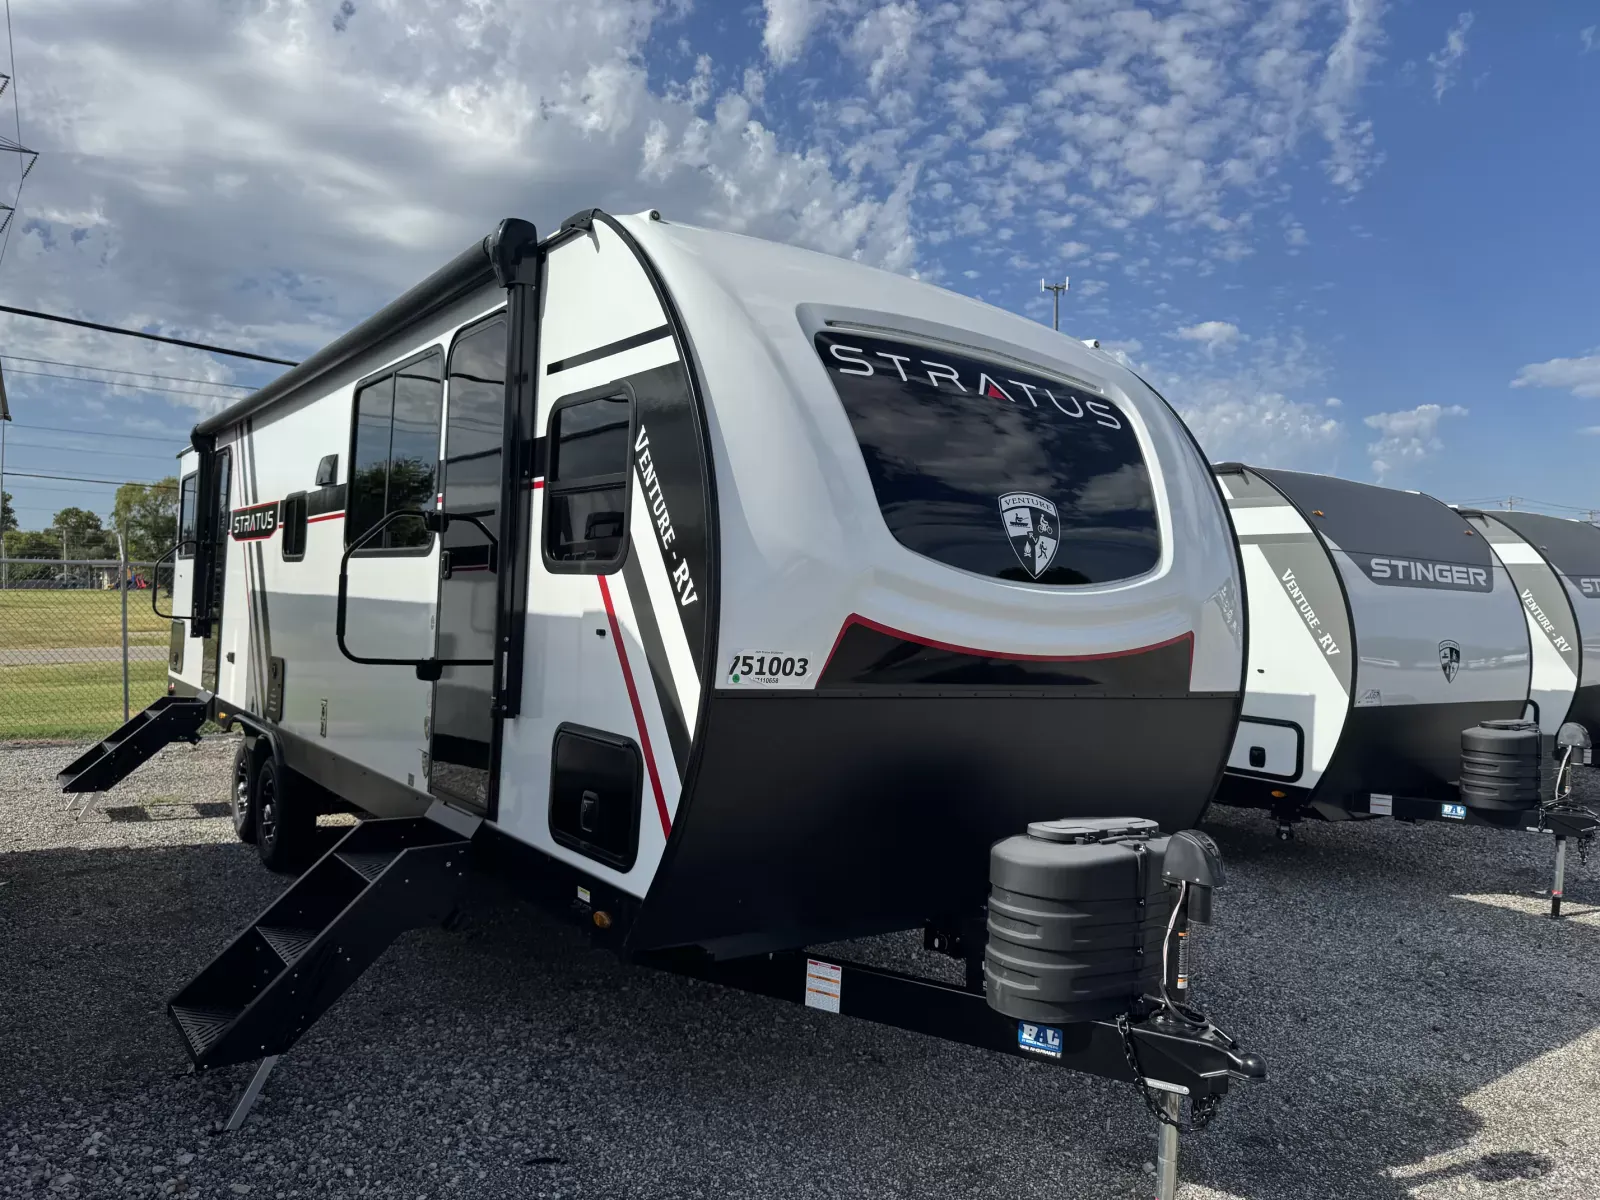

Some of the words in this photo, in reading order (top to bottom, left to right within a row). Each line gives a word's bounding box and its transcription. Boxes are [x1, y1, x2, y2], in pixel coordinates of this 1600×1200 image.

[829, 343, 1122, 431] STRATUS
[233, 510, 275, 534] STRATUS
[634, 424, 676, 550] VENTURE
[672, 558, 699, 608] RV
[1004, 497, 1053, 512] VENTURE
[1370, 557, 1488, 587] STINGER
[1280, 567, 1321, 630] VENTURE
[1319, 632, 1341, 657] RV
[1521, 588, 1556, 636] VENTURE
[1553, 634, 1572, 653] RV
